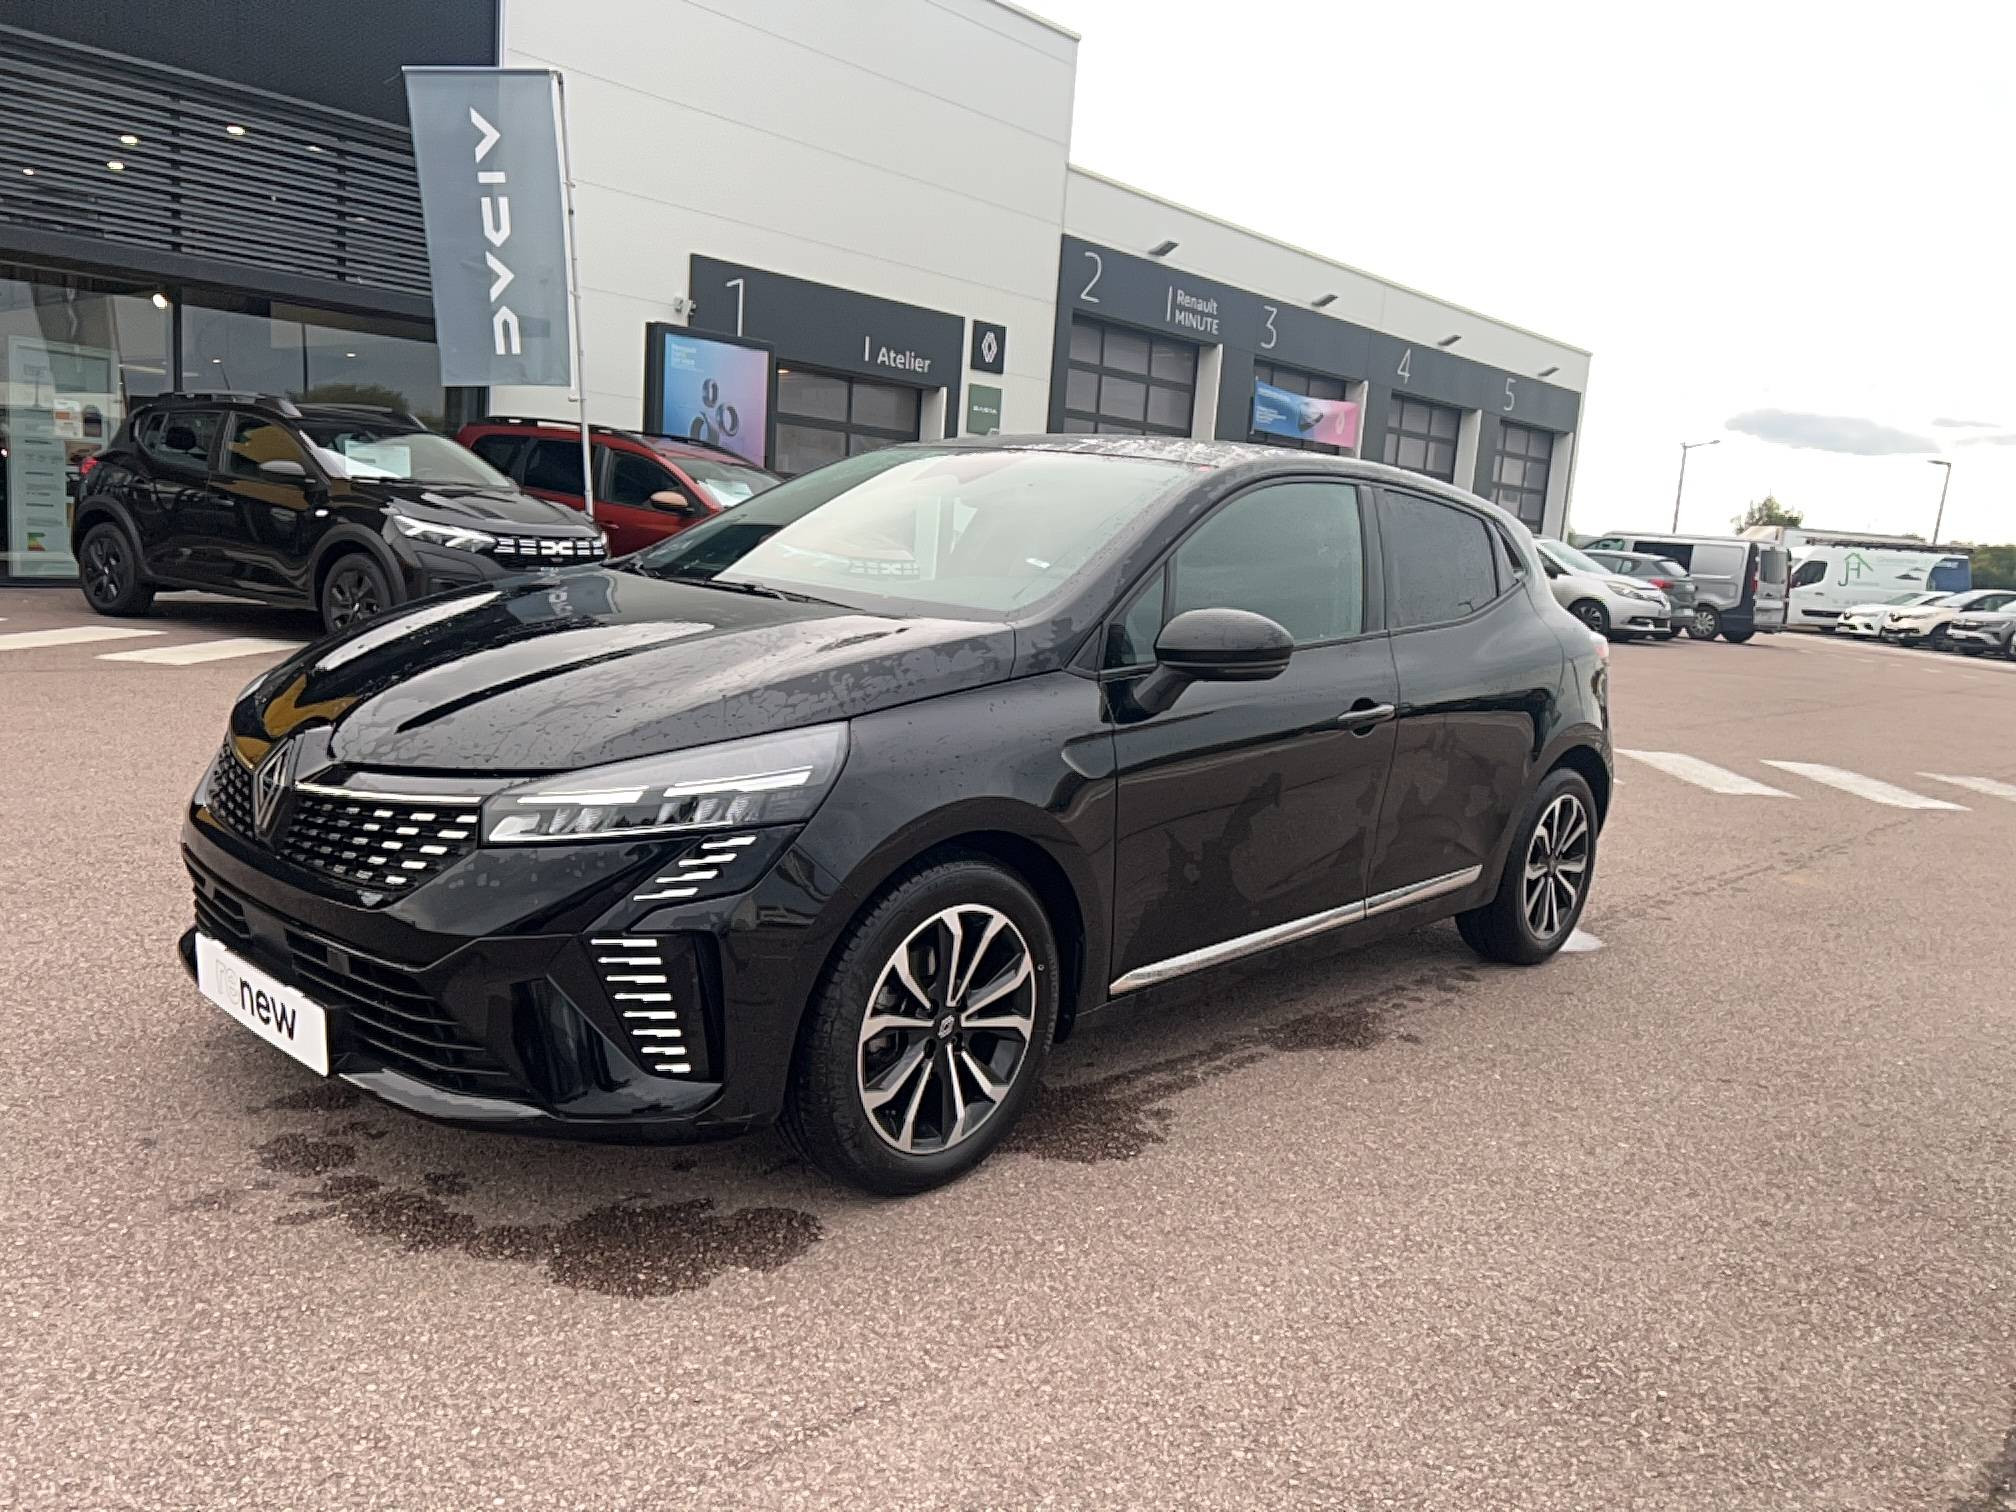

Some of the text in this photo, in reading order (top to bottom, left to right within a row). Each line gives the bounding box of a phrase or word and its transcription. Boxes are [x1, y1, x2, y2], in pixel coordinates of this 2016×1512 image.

[1080, 251, 1102, 303] 2
[726, 278, 744, 337] 1
[1176, 289, 1218, 315] Renault
[1175, 309, 1219, 335] MINUTE
[1260, 305, 1278, 349] 3
[877, 346, 931, 372] Atelier
[1397, 348, 1411, 384] 4
[1503, 377, 1517, 411] 5
[215, 959, 296, 1041] renew
